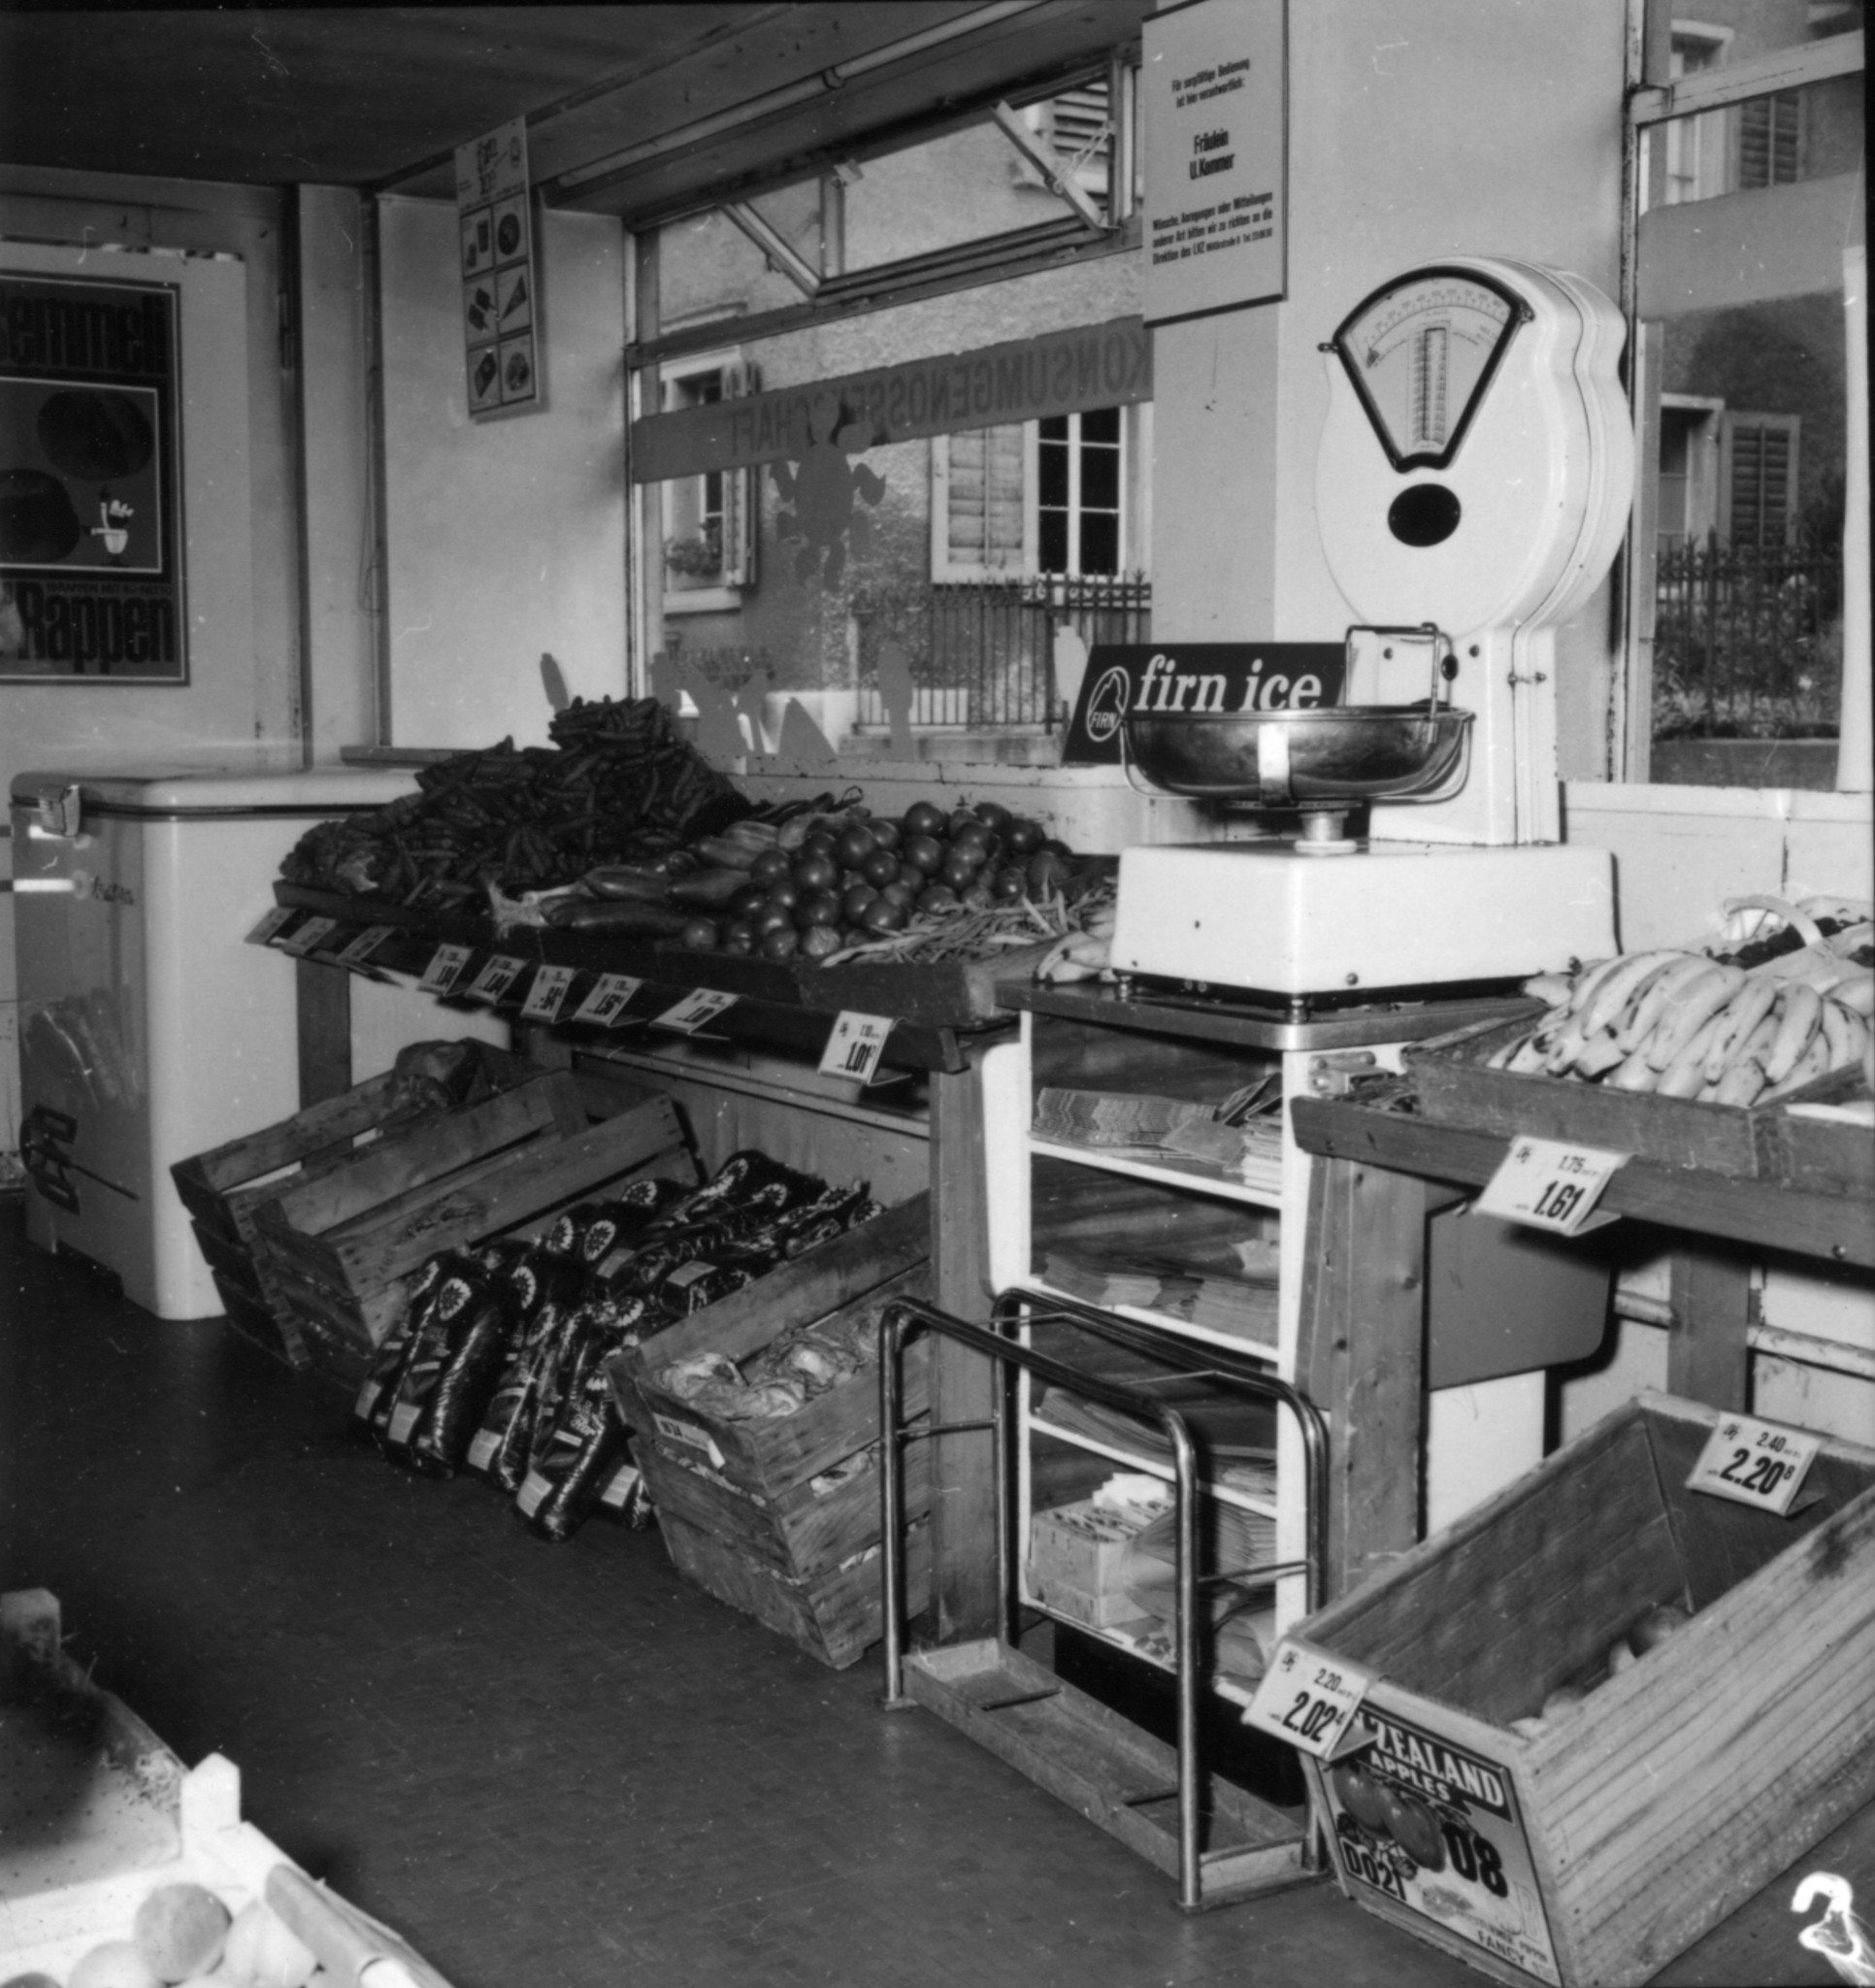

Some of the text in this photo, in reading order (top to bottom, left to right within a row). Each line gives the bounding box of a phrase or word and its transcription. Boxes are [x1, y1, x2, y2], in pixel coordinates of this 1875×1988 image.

[1194, 128, 1229, 155] Fräulein
[16, 582, 175, 675] Rappen
[1133, 653, 1322, 712] firn ice
[1090, 711, 1118, 729] FIRN
[1558, 1154, 1587, 1175] 1.75
[1533, 1180, 1587, 1222] 1.61
[1756, 1432, 1787, 1453] 2.40
[1313, 1667, 1343, 1692] 2.20
[1281, 1690, 1338, 1743] 2.02
[1369, 1749, 1451, 1803] APPLES
[1370, 1718, 1505, 1808] ZEALAND
[1477, 1930, 1525, 1967] FANCY
